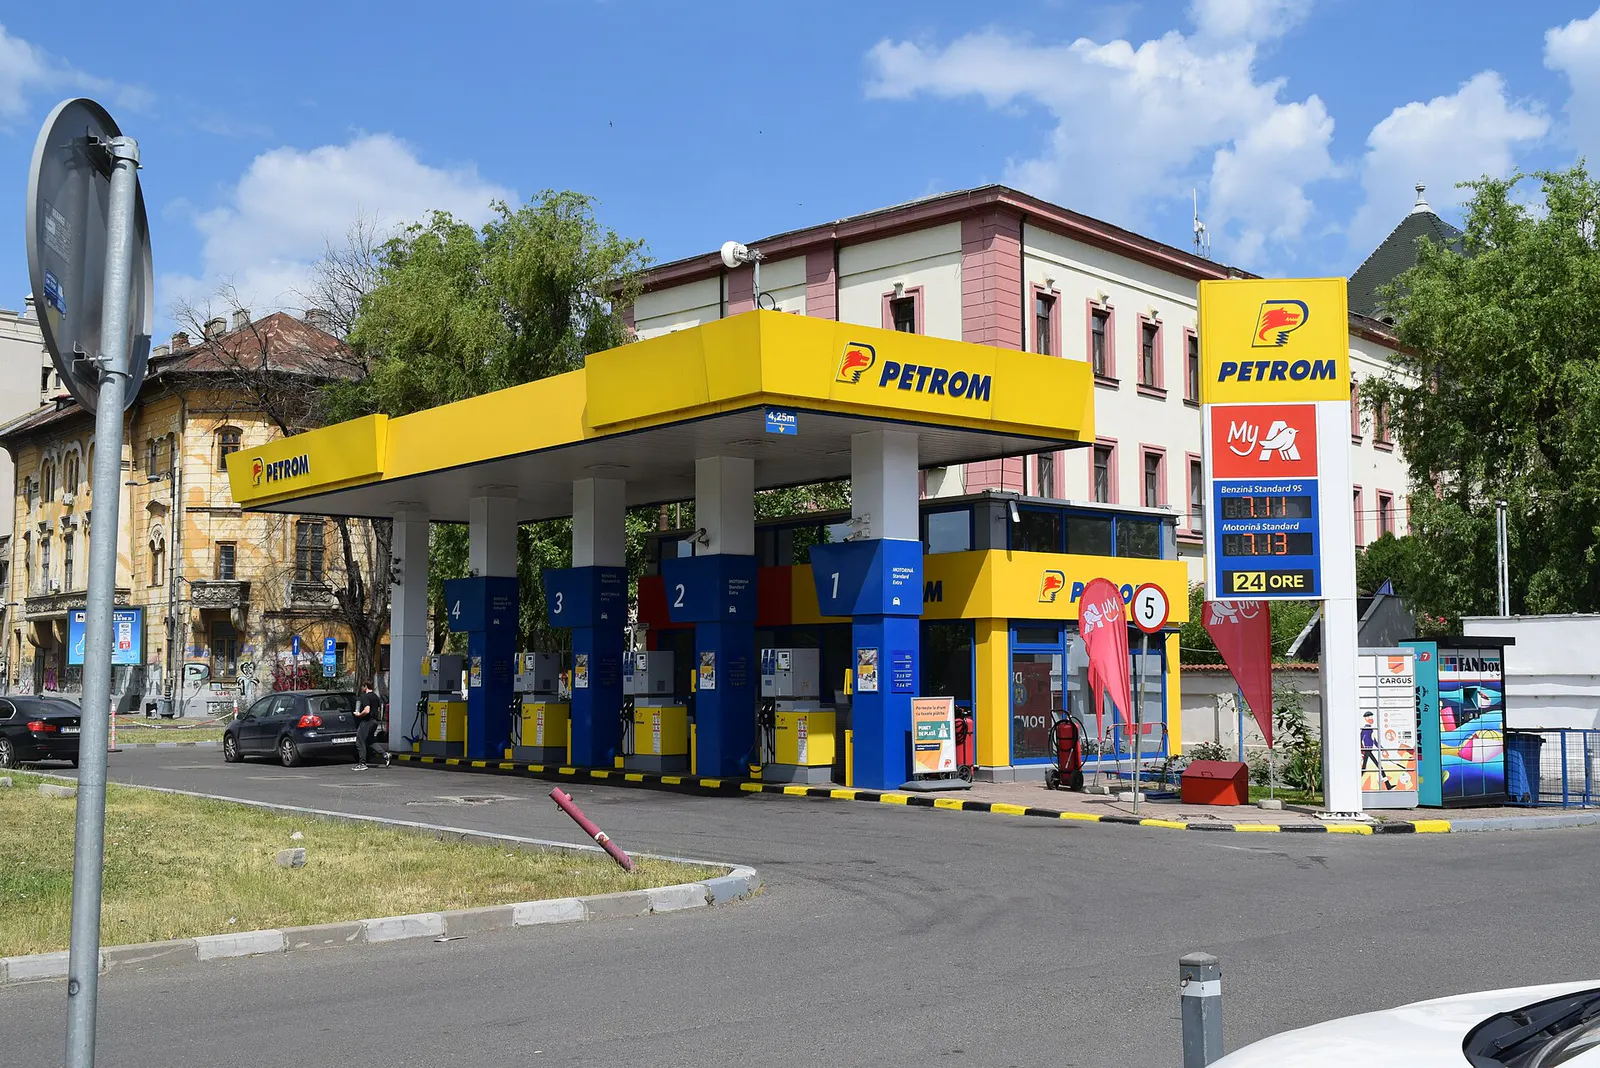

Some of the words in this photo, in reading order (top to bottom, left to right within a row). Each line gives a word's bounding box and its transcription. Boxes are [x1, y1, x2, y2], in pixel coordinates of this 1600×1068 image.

[879, 360, 992, 401] PETROM
[1217, 359, 1337, 382] PETROM
[768, 411, 795, 423] 4,25m
[1227, 420, 1259, 456] My
[266, 453, 310, 483] PETROM
[1254, 484, 1291, 493] Standard
[1292, 484, 1303, 492] 95
[1242, 496, 1287, 518] 7.11
[1222, 523, 1261, 531] Motorină
[1262, 521, 1300, 530] Standard
[1243, 532, 1288, 555] 7.13
[831, 572, 840, 599] 1
[1236, 573, 1264, 590] 24
[1269, 574, 1305, 588] ORE
[553, 592, 563, 614] 3
[673, 583, 685, 608] 2
[451, 600, 461, 620] 4
[1144, 596, 1155, 620] 5
[326, 640, 333, 650] P
